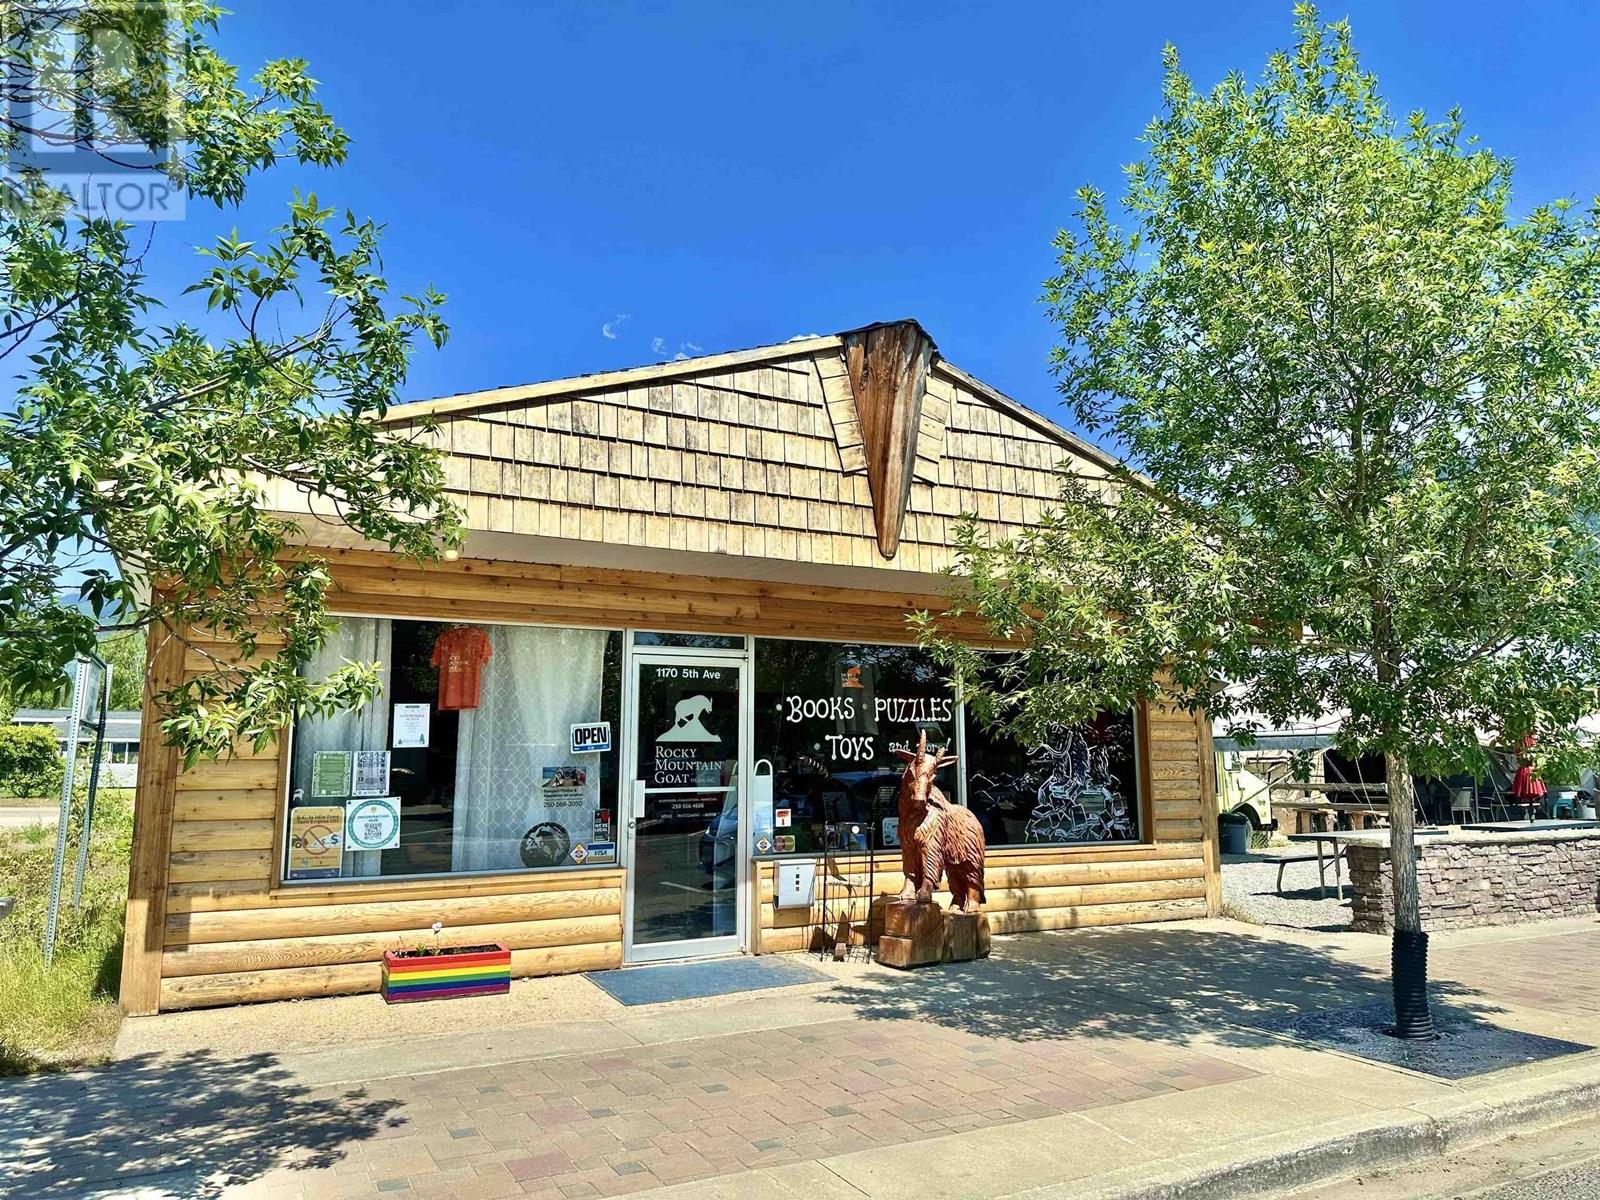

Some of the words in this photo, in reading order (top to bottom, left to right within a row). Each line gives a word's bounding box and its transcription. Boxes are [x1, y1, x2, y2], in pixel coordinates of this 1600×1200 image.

[656, 667, 678, 678] 1170
[682, 668, 699, 679] 5th
[702, 669, 721, 680] Ave
[785, 695, 855, 723] BOOKS
[874, 697, 953, 722] PUZZLES
[574, 726, 608, 745] OPEN
[655, 745, 697, 758] ROCKY
[824, 734, 874, 761] TOYS
[654, 758, 723, 771] MOUNTAIN
[654, 771, 690, 784] GOAT
